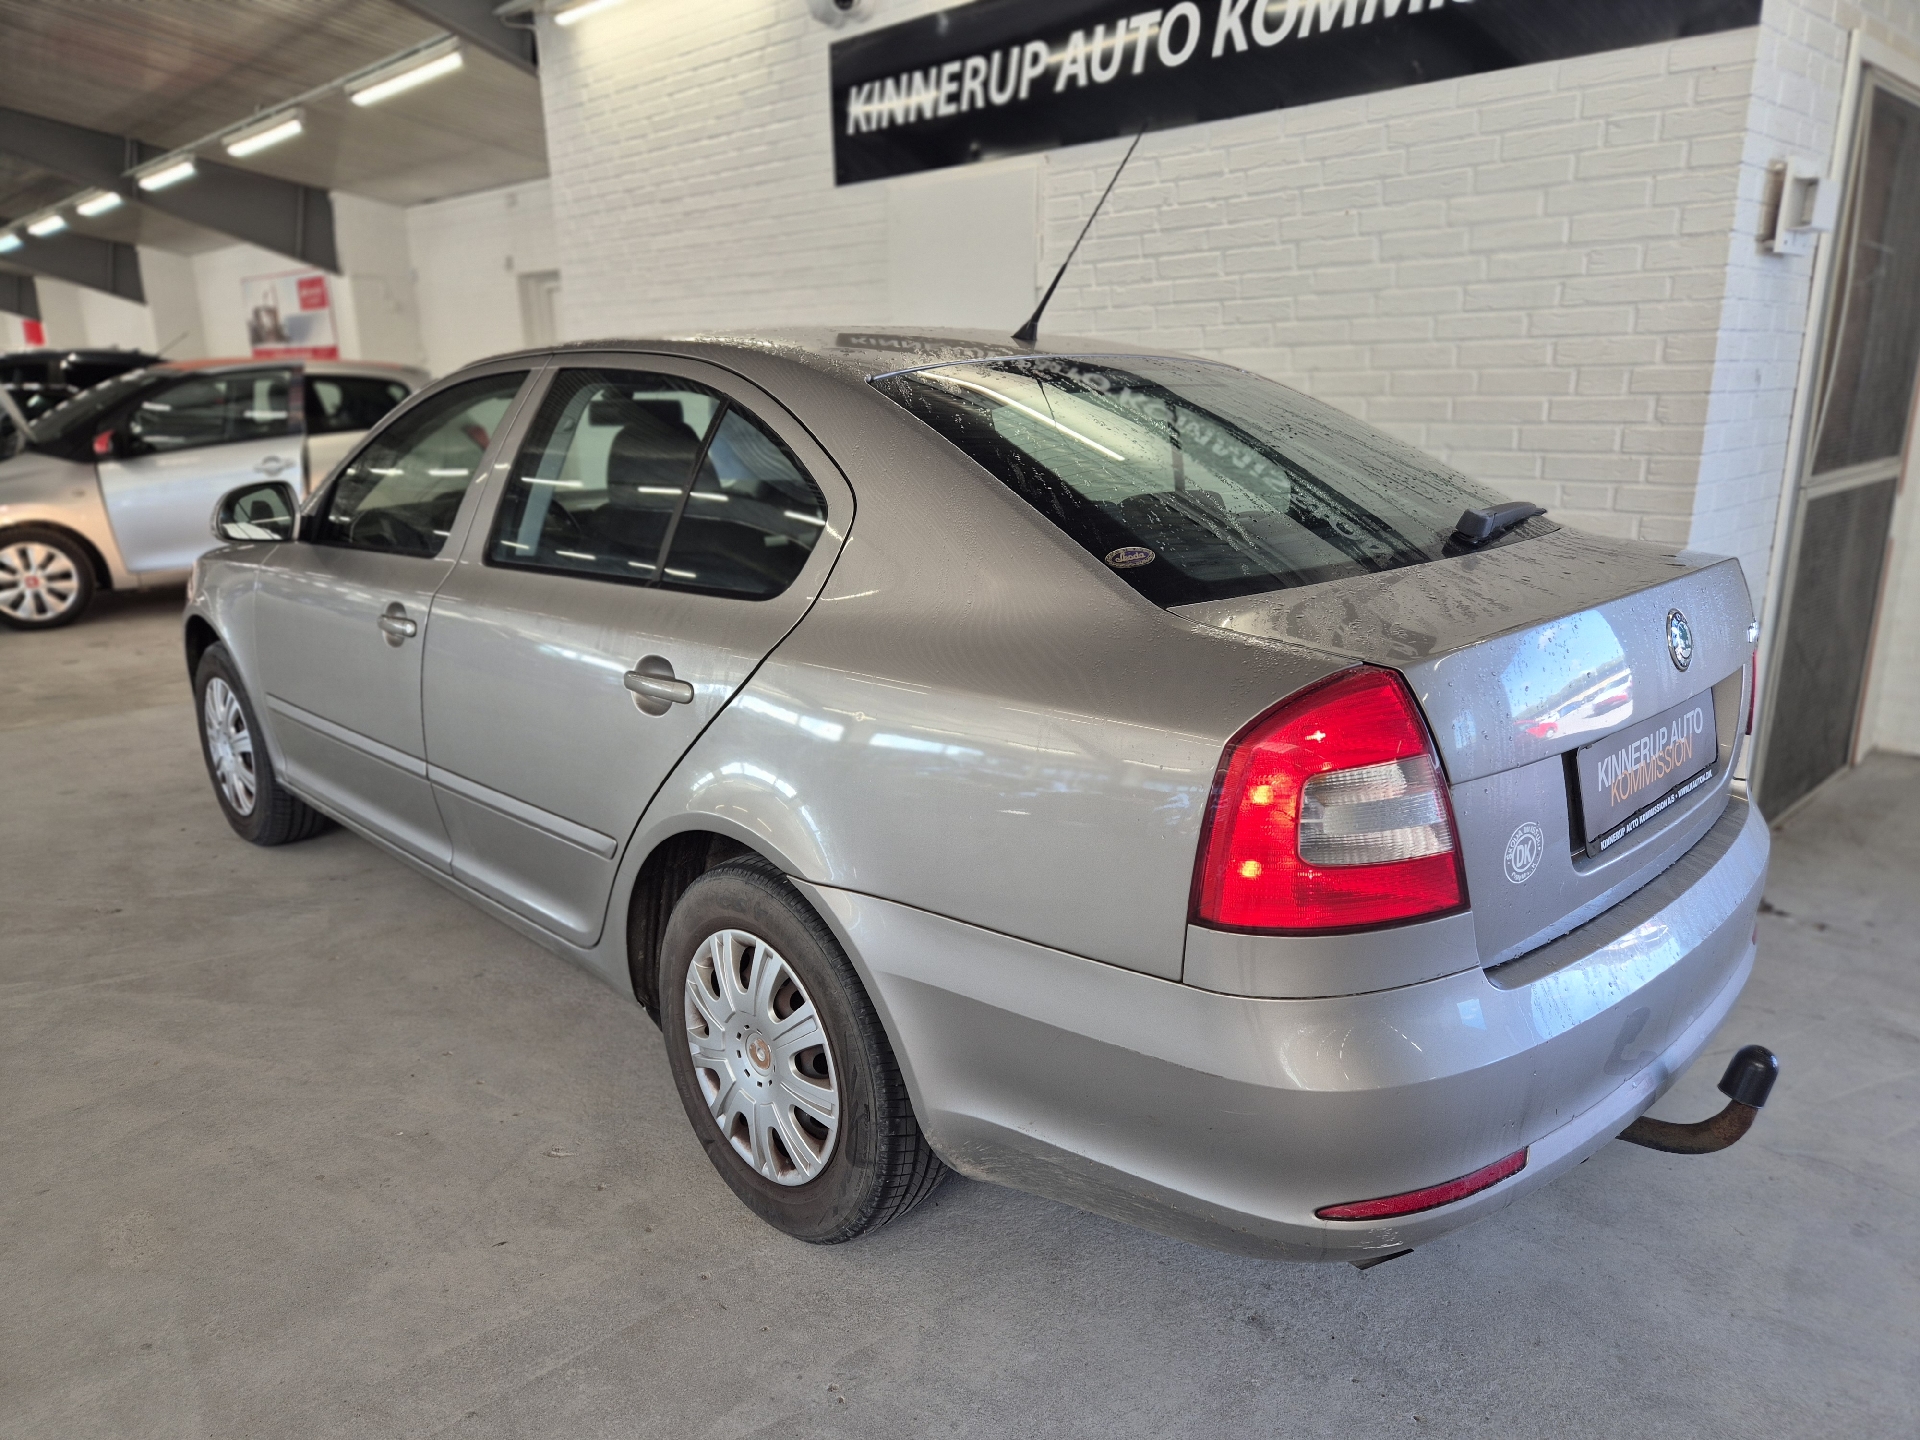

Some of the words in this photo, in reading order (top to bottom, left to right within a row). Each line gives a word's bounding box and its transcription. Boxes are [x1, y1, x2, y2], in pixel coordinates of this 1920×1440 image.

[846, 39, 1050, 135] KINNERUP
[1054, 1, 1201, 93] AUTO
[1211, 0, 1475, 58] KOM
[1597, 726, 1668, 793] KINNERUP
[1670, 707, 1704, 750] AUTO
[1611, 732, 1693, 807] KOMMISSION
[1516, 839, 1532, 868] DK
[1600, 827, 1625, 851] KINNERUP
[1626, 819, 1639, 834] AUTO
[1639, 800, 1668, 825] KOMMISSION
